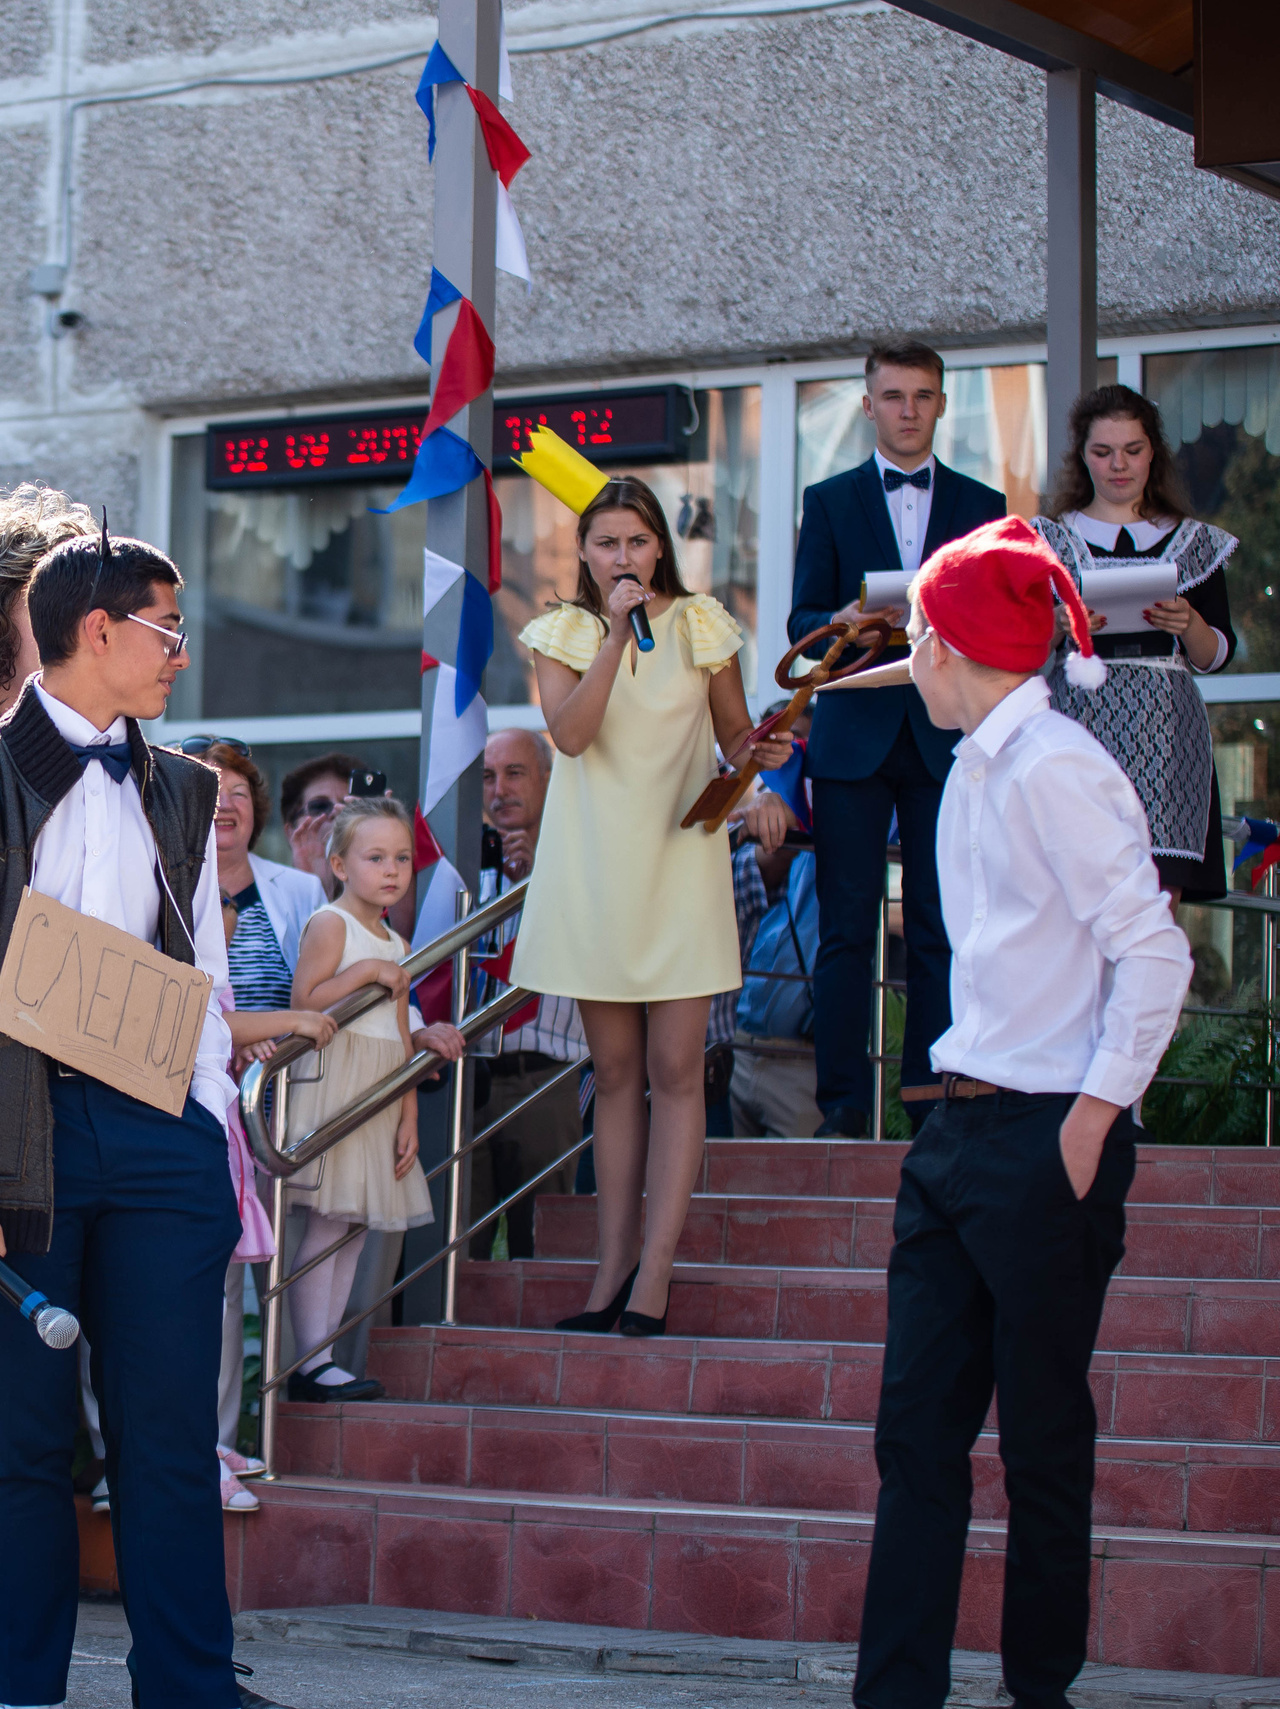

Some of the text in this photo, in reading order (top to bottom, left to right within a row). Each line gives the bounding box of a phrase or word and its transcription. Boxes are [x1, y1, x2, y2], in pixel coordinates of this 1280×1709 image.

[225, 438, 268, 473] 02
[571, 408, 613, 446] 12
[14, 912, 204, 1087] СЛЕПОЙ
